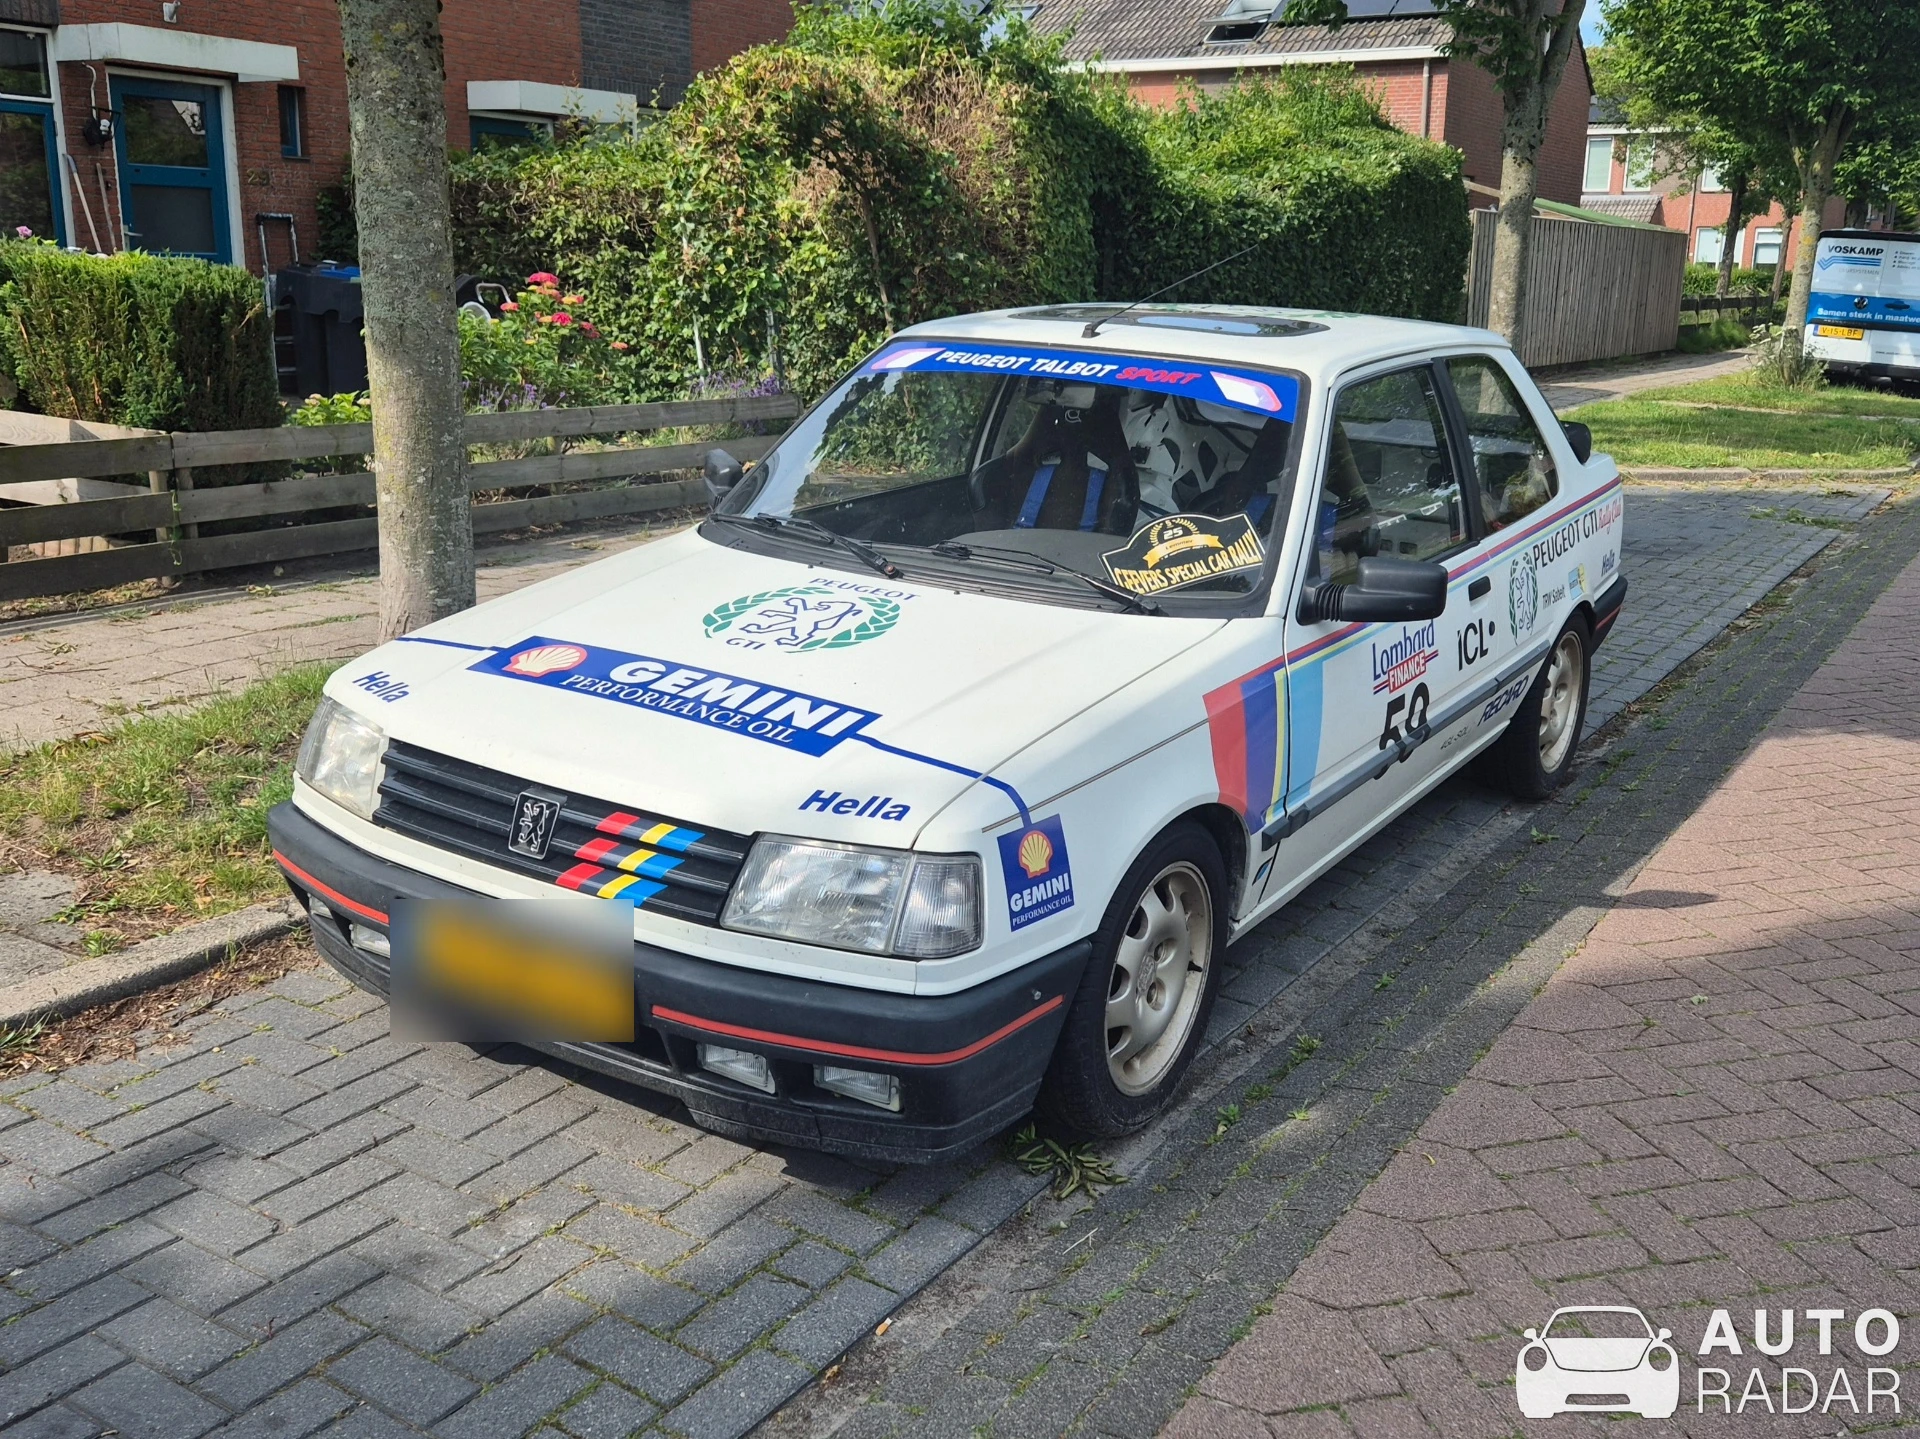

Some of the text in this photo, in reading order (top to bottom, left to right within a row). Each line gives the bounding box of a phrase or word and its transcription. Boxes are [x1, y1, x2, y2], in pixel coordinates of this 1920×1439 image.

[1828, 245, 1884, 256] VOSKAMP
[1816, 307, 1847, 317] Samen
[1849, 311, 1873, 320] sterk
[1874, 312, 1883, 320] in
[1822, 326, 1859, 337] V-15-LBF
[936, 351, 1202, 385] PEUGEOT TALBOT SPORT
[1163, 526, 1184, 540] 25
[1533, 518, 1580, 571] PEUGEOT
[1583, 509, 1598, 539] GTI
[1165, 558, 1211, 584] SPECIAL
[1208, 551, 1232, 573] CAR
[1230, 528, 1263, 567] RALLY
[809, 577, 922, 601] PEUGEOT
[726, 637, 768, 650] GTI
[1372, 619, 1435, 681] Lombard
[352, 671, 410, 703] Hella
[1388, 651, 1426, 692] FINANCE
[560, 674, 798, 744] PERFORMANCE OIL
[609, 661, 865, 738] GEMINI
[1477, 675, 1529, 727] RECARO
[798, 789, 911, 821] Hella
[1010, 873, 1070, 912] GEMINI
[1012, 894, 1073, 927] PERFORMANCE OIL
